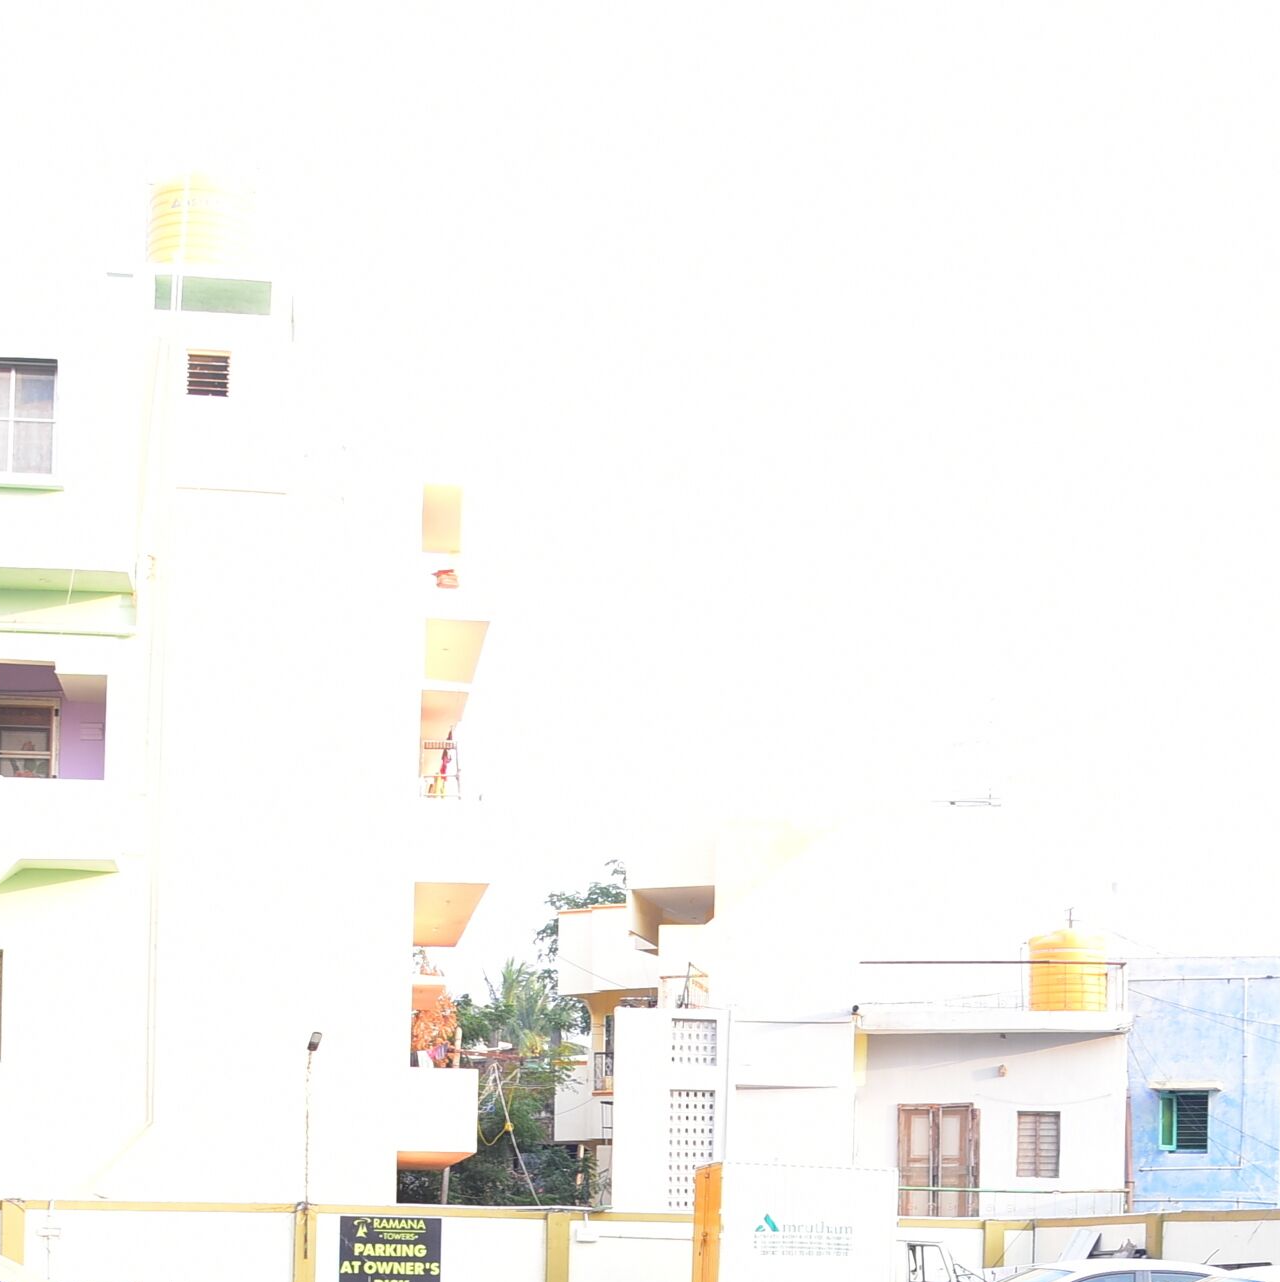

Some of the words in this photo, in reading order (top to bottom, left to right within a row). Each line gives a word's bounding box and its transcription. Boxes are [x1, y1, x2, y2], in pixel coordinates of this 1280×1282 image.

[373, 1218, 426, 1230] RAMANA
[383, 1232, 416, 1240] TOWERS
[353, 1243, 427, 1257] PARKING
[340, 1261, 361, 1274] AT
[363, 1261, 440, 1275] OWNER'S
